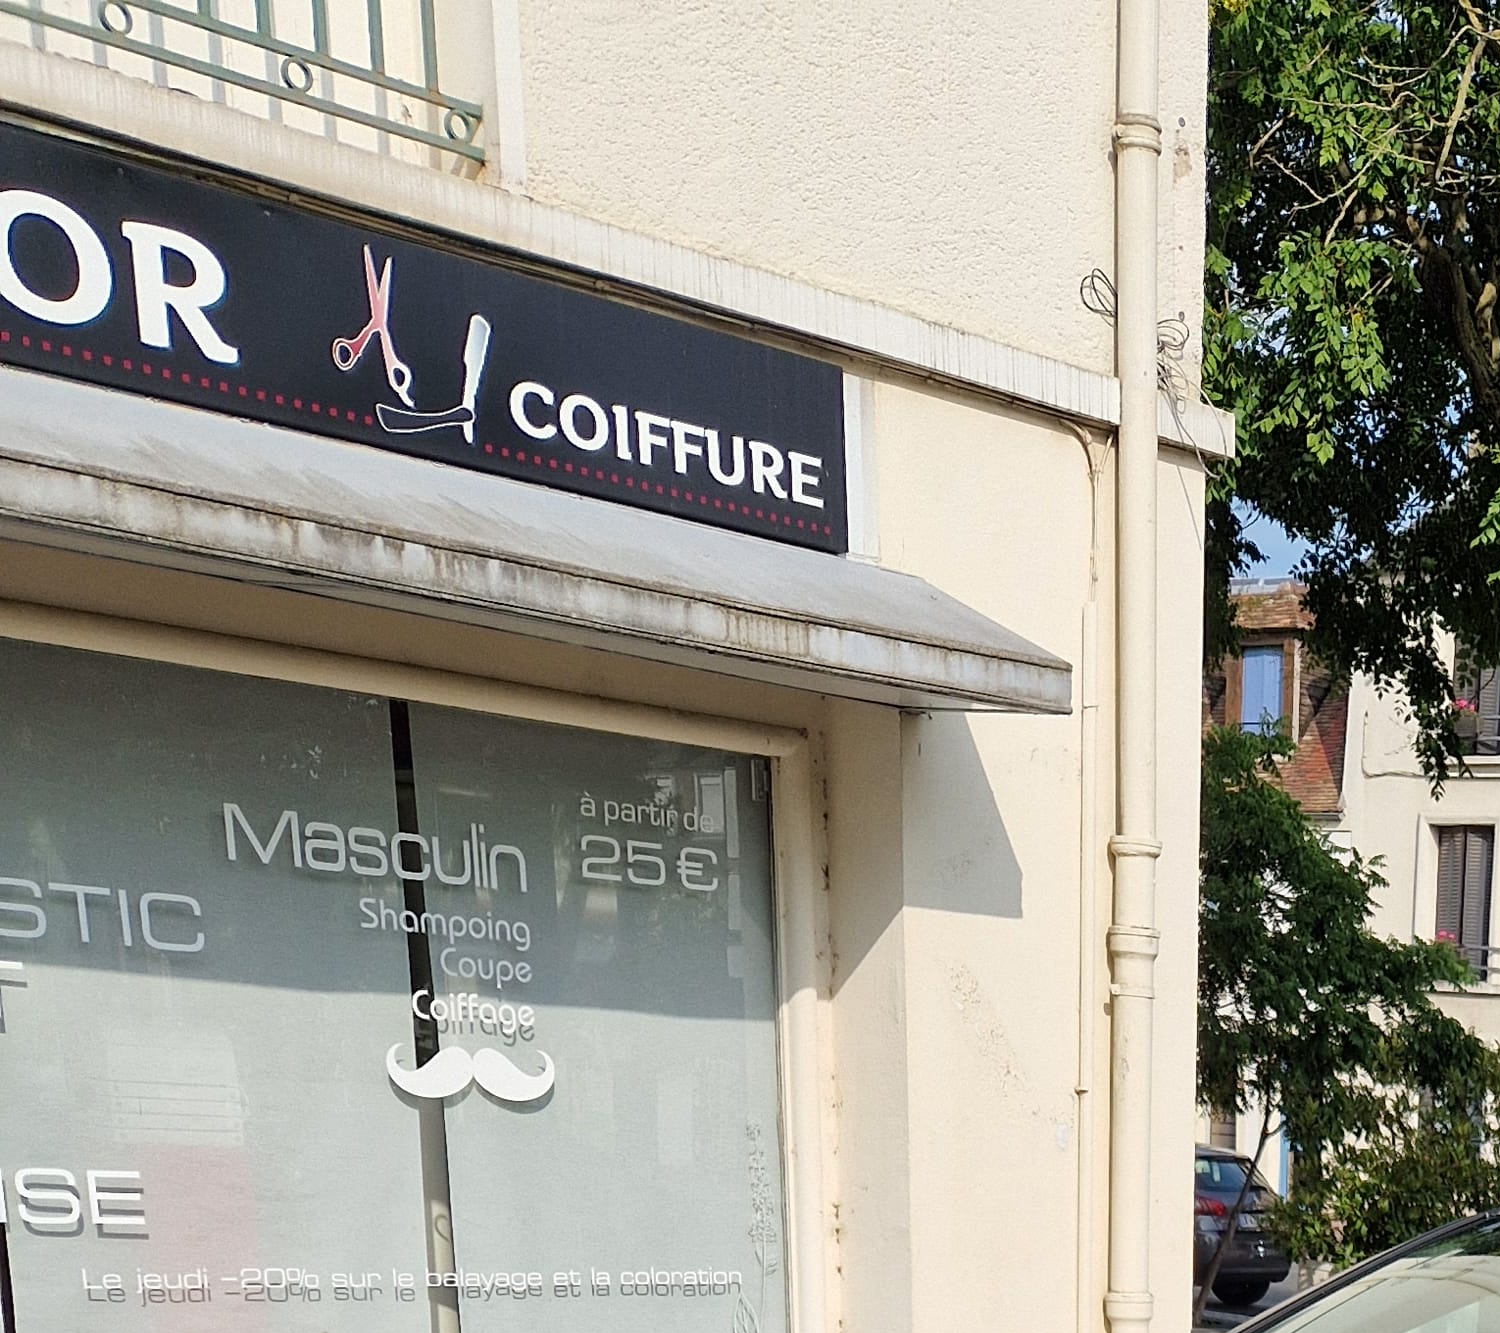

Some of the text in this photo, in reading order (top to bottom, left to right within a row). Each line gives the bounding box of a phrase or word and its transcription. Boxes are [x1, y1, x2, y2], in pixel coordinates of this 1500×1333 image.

[0, 188, 825, 508] OR COIFFURE
[580, 791, 714, 833] à partir de
[222, 802, 528, 893] Masculin
[0, 877, 205, 952] STIC
[359, 897, 531, 952] Shampoing
[440, 947, 532, 989] Coupe
[412, 989, 536, 1034] Coiffage
[81, 1266, 743, 1294] Le jeudi -20% sur le balayage et la coloration
